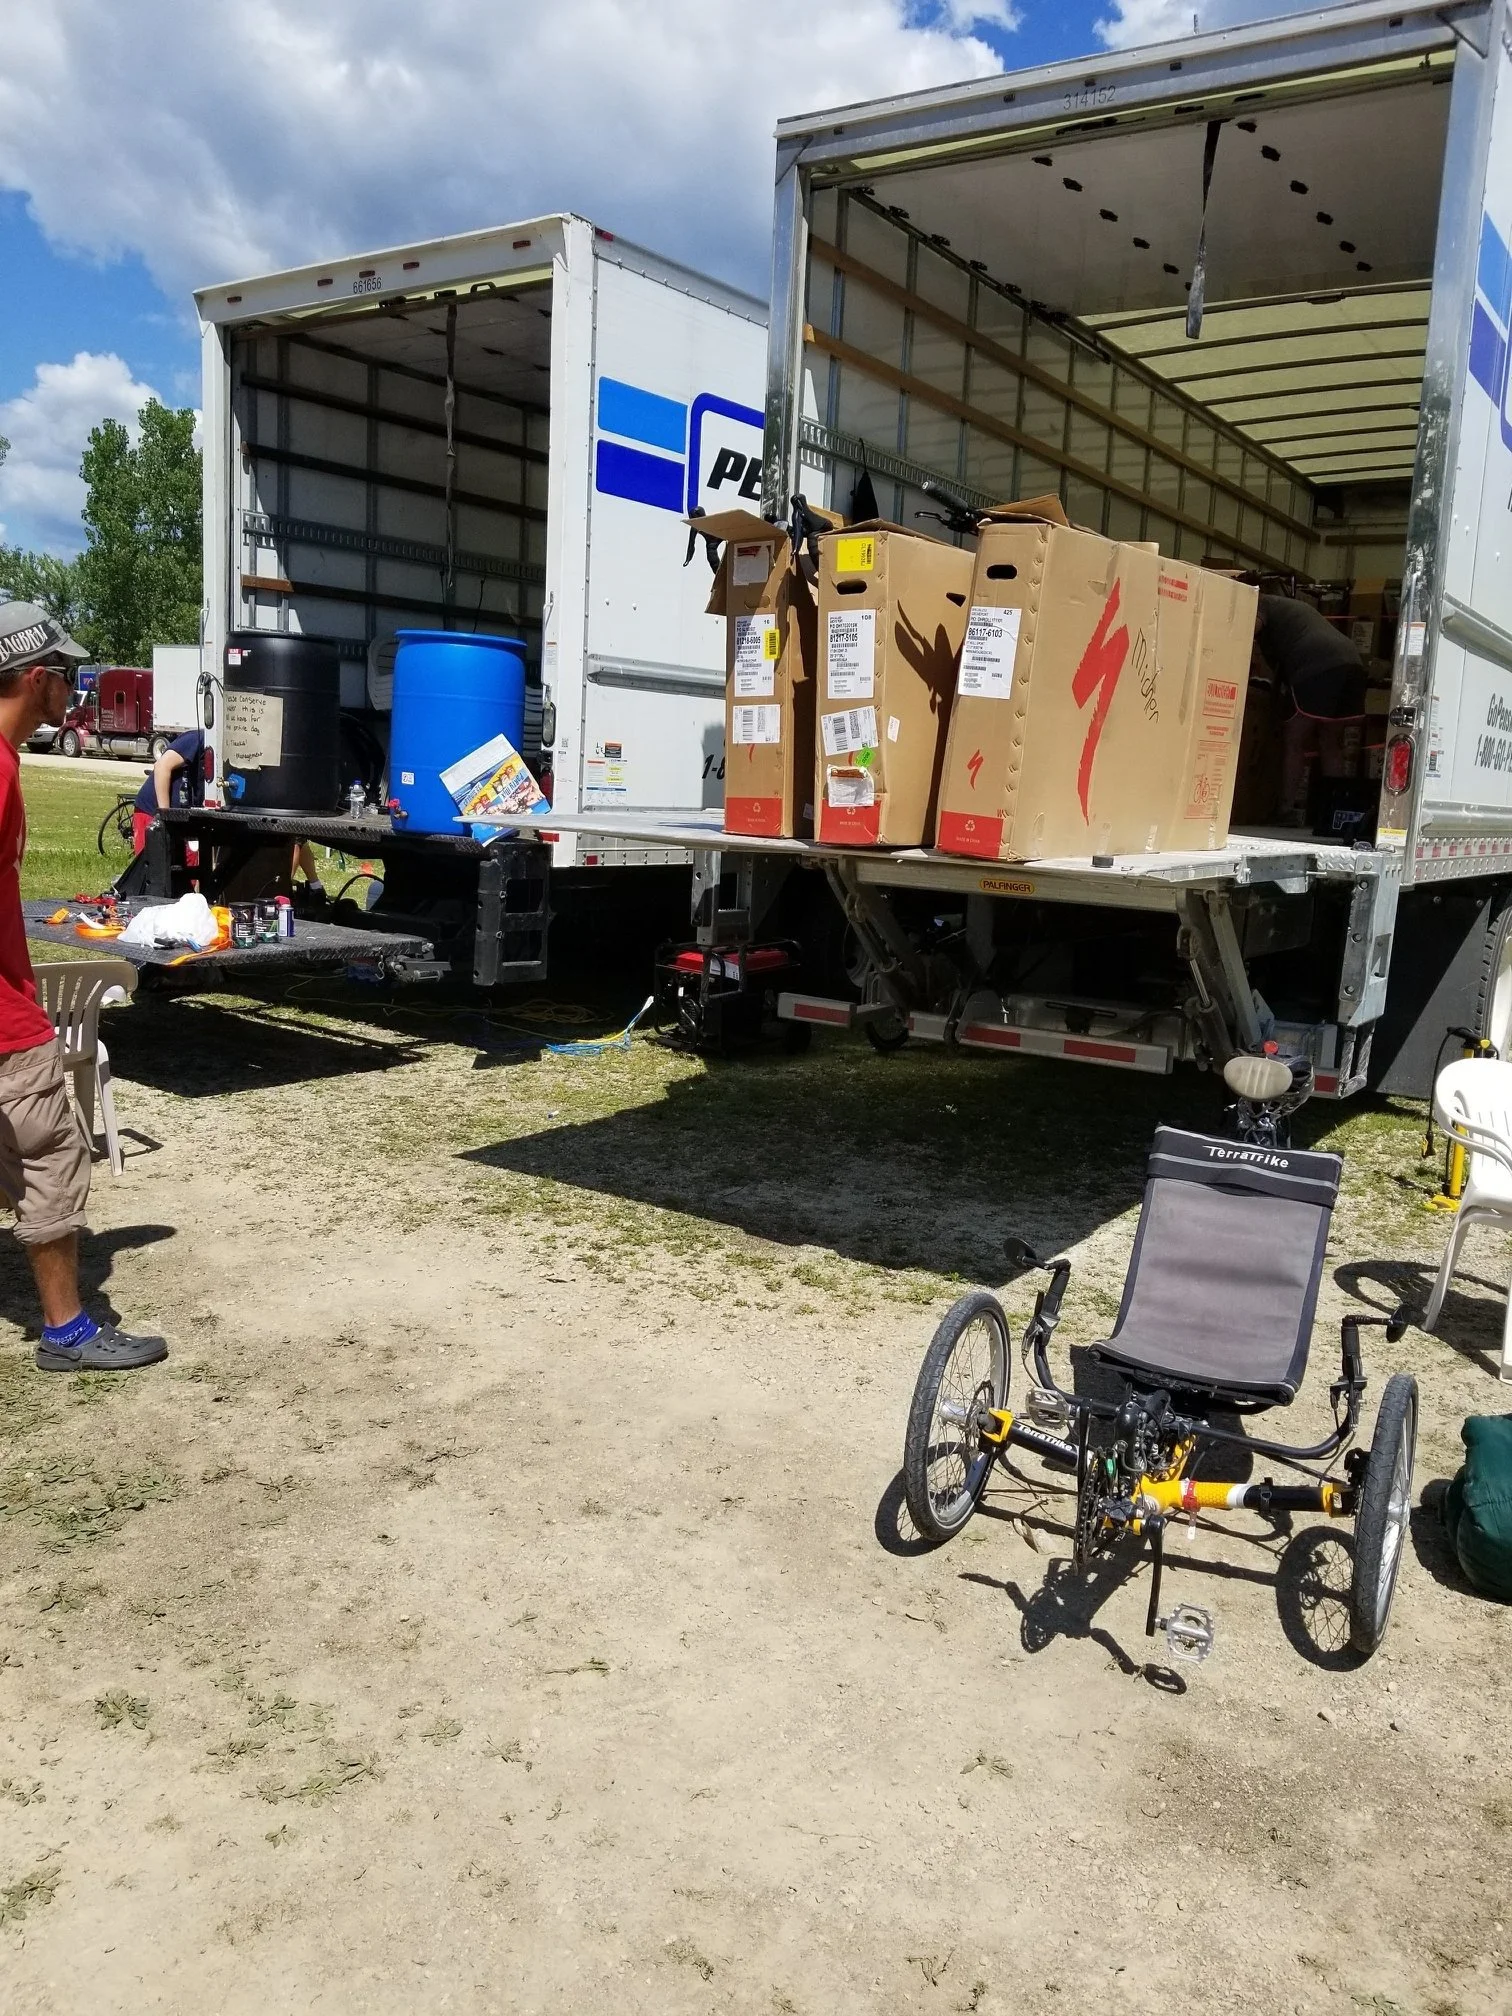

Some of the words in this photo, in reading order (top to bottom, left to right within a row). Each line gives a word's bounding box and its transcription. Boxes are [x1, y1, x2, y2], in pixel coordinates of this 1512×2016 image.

[1063, 85, 1116, 111] 314152
[352, 277, 382, 294] 661656
[983, 880, 1031, 892] PALFINGER
[1203, 1145, 1289, 1168] TerraTrike
[1014, 1420, 1073, 1451] TerraTrike
